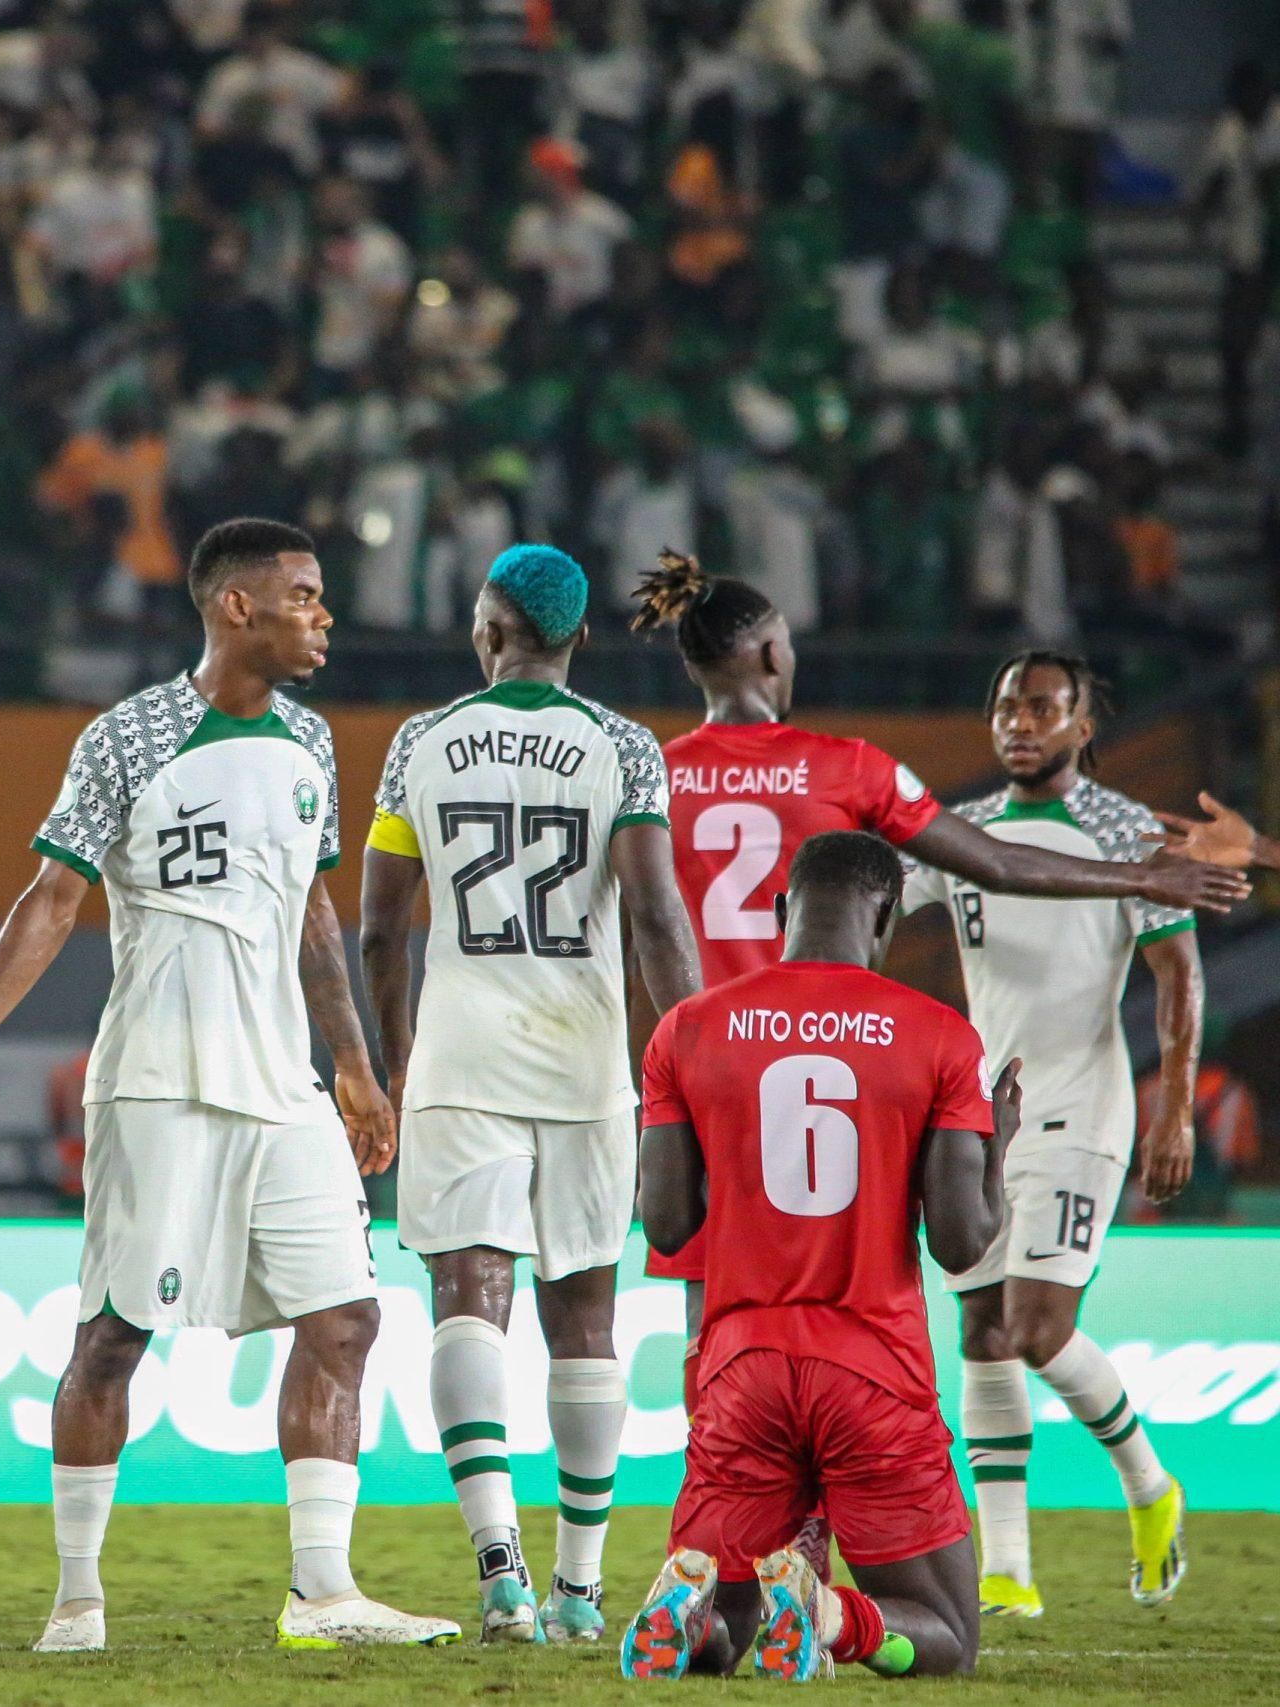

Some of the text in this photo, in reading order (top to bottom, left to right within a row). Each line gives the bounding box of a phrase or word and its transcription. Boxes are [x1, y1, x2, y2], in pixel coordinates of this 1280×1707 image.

[445, 731, 586, 777] OMERUO
[671, 760, 809, 795] FALI CANDÉ
[157, 820, 228, 889] 25
[437, 802, 592, 958] 22
[693, 803, 782, 940] 2
[953, 892, 985, 949] 18
[728, 1009, 895, 1046] NITO GOMES
[759, 1054, 859, 1217] 6
[1055, 1190, 1095, 1254] 18
